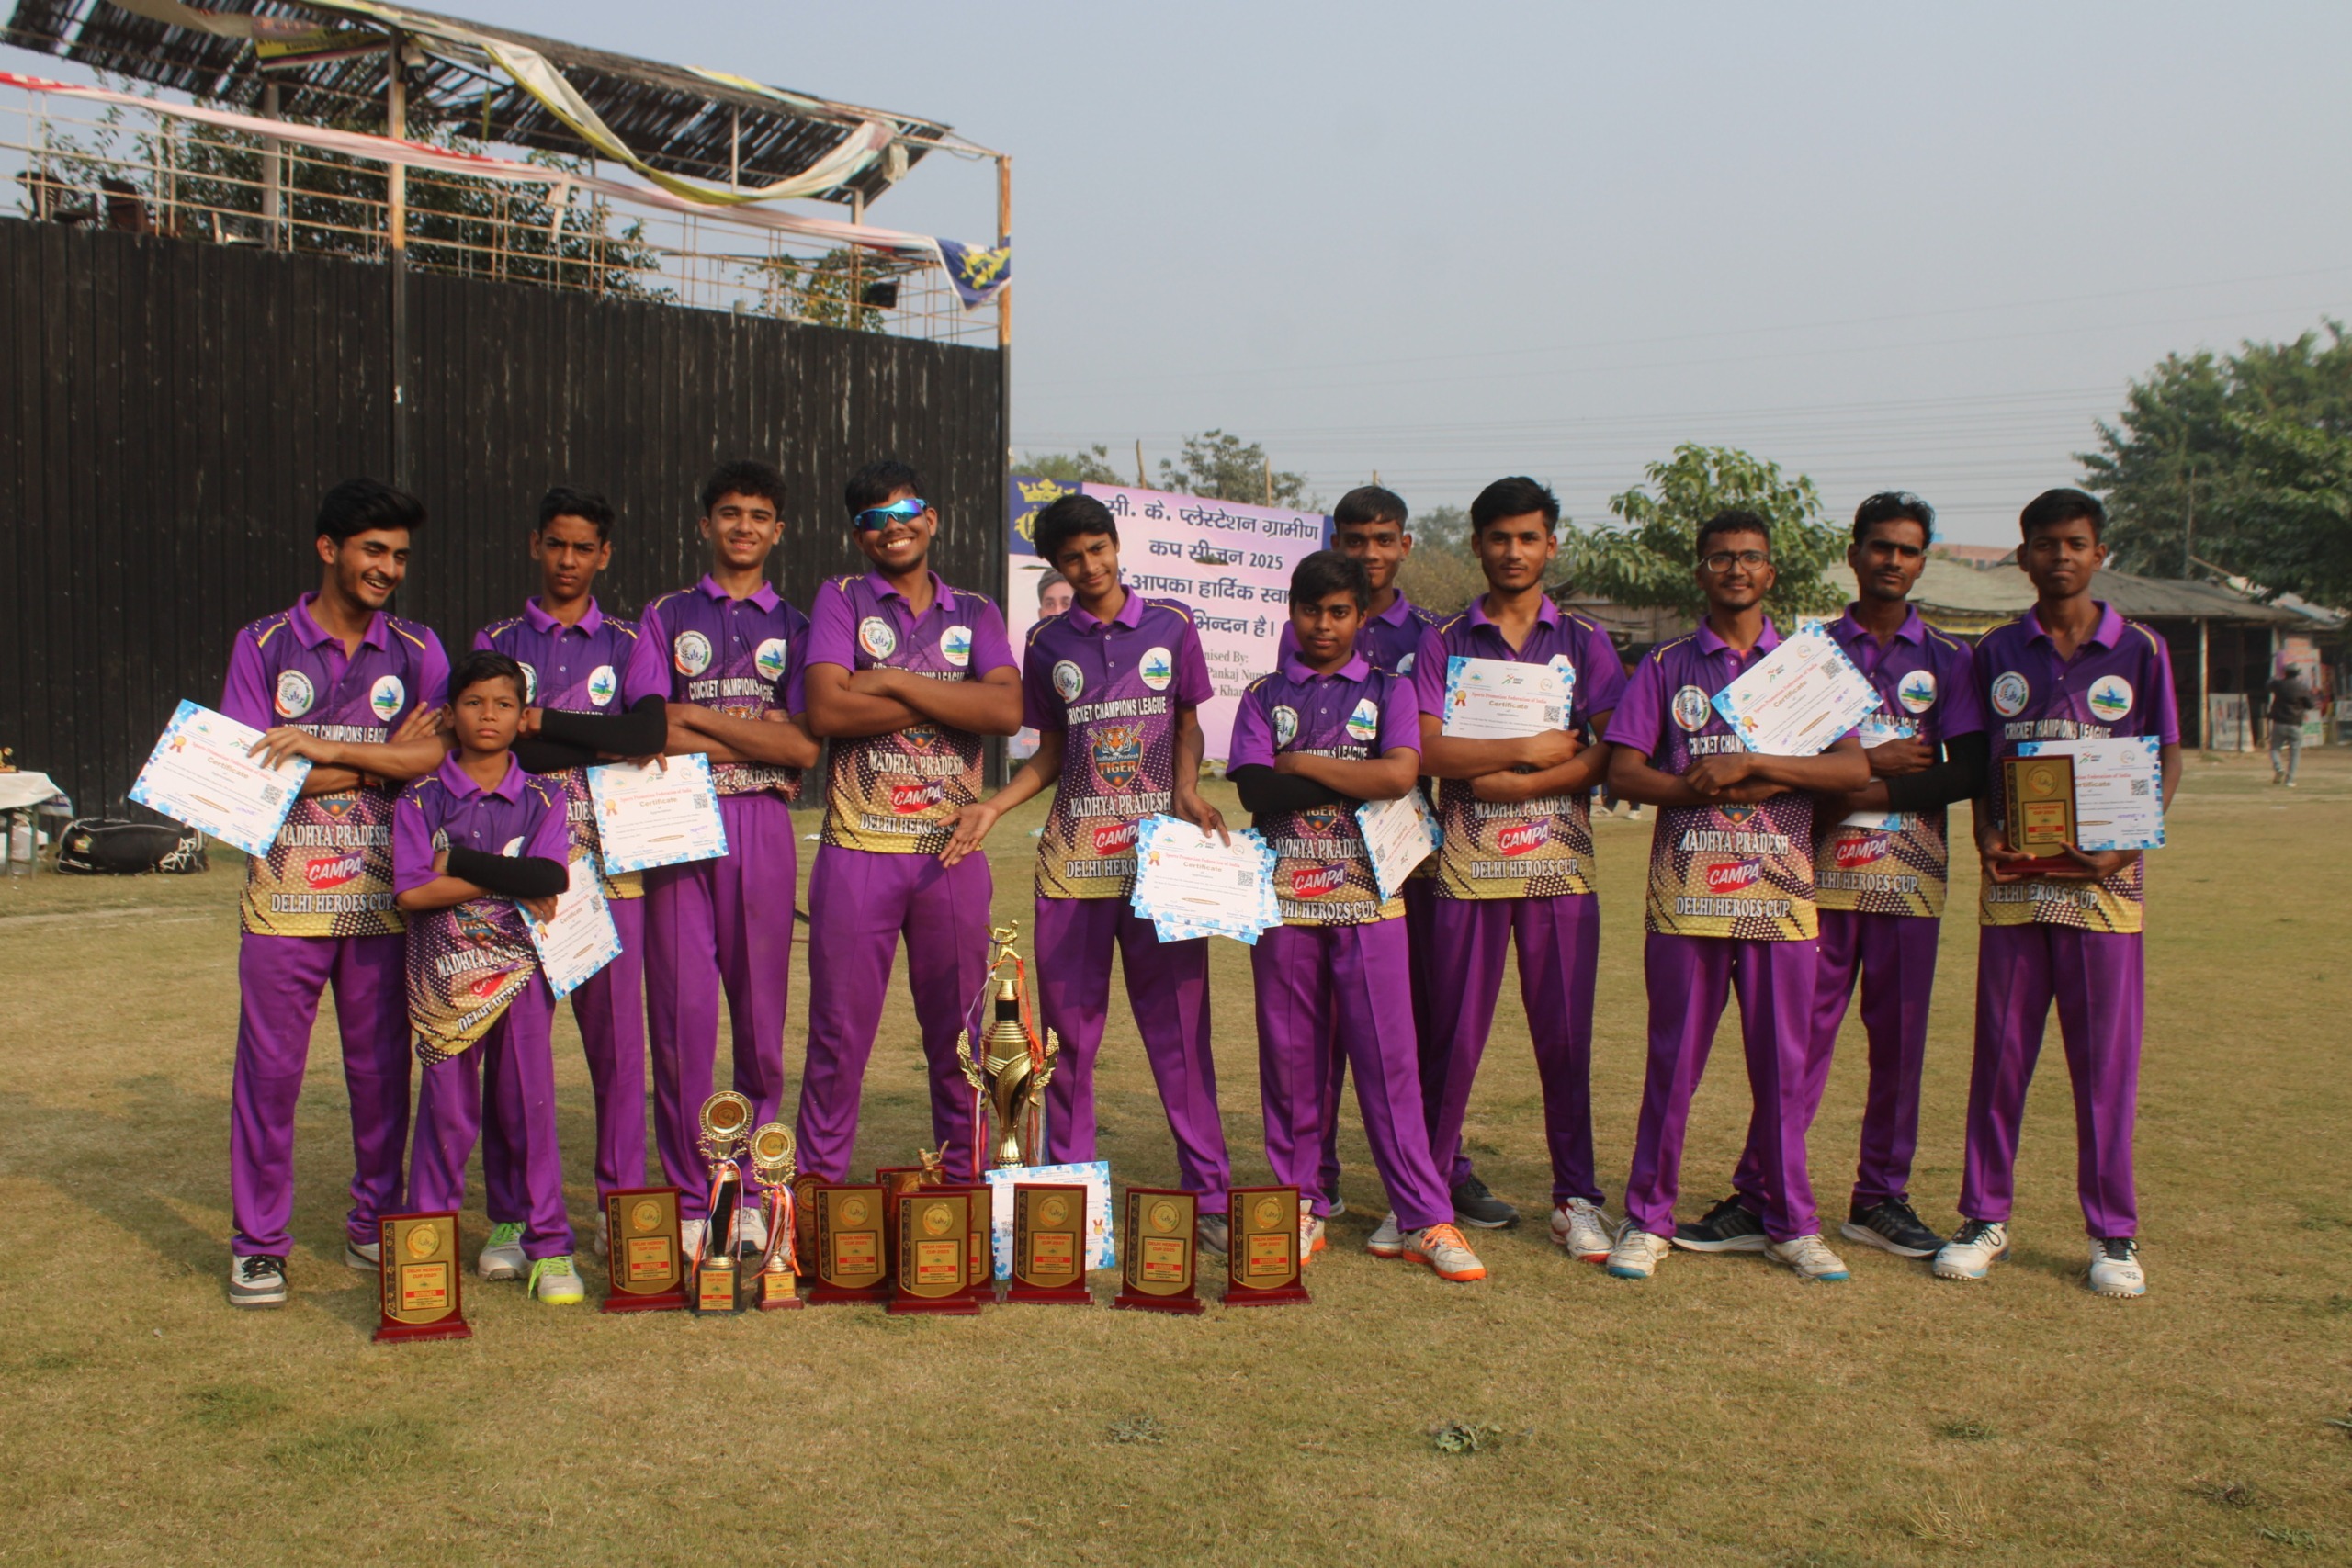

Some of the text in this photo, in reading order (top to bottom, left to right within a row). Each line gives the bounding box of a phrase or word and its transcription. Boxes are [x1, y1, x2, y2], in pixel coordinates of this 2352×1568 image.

[1144, 500, 1171, 521] के.
[1179, 504, 1258, 533] प्लेस्टेशन
[1262, 517, 1319, 540] ग्रामीण
[1148, 539, 1182, 558] कप
[1250, 553, 1283, 570] 2025
[1131, 574, 1193, 594] आपका
[1198, 577, 1254, 600] हार्दिक
[1261, 587, 1290, 604] स्वा
[1192, 608, 1248, 634] भिन्दन
[1204, 649, 1249, 666] nised By:
[689, 680, 719, 700] CRICKET
[1773, 680, 1808, 707] Certificate
[1067, 696, 1167, 726] RICKET CHAMPIONS LEAGUE
[1488, 700, 1529, 710] Certificate
[208, 756, 249, 780] Certificate
[868, 750, 964, 777] MADHYA PRADESH
[1098, 761, 1136, 774] TIGER
[639, 797, 678, 807] Certificate
[893, 786, 943, 807] CAMPA
[1118, 791, 1172, 816] PRADESH
[1523, 795, 1572, 817] PRADESH
[860, 813, 898, 833] DELHI
[277, 825, 390, 847] MADHYA PRADESH
[1501, 824, 1549, 849] CAMPA
[1680, 831, 1790, 854] MADHYA PRADESH
[1838, 840, 1887, 860] CAMPA
[309, 858, 363, 882] CAMPA
[1066, 858, 1138, 879] DELHI HERO
[1183, 862, 1222, 873] Certificate
[1471, 858, 1578, 879] DELHI HEROES CUP
[1710, 863, 1760, 886] CAMPA
[1295, 867, 1345, 891] CAMPA
[1842, 873, 1892, 893] HEROES
[1893, 875, 1918, 894] CUP
[271, 893, 396, 913] DELHI HEROES CUP
[1676, 897, 1791, 918] DELHI HEROES CUP
[1989, 885, 2024, 903] DELHI
[2070, 889, 2098, 909] CUP
[560, 907, 583, 924] Certificate
[1279, 899, 1377, 919] LHI HEROES CUP
[435, 948, 489, 977] MADHYA
